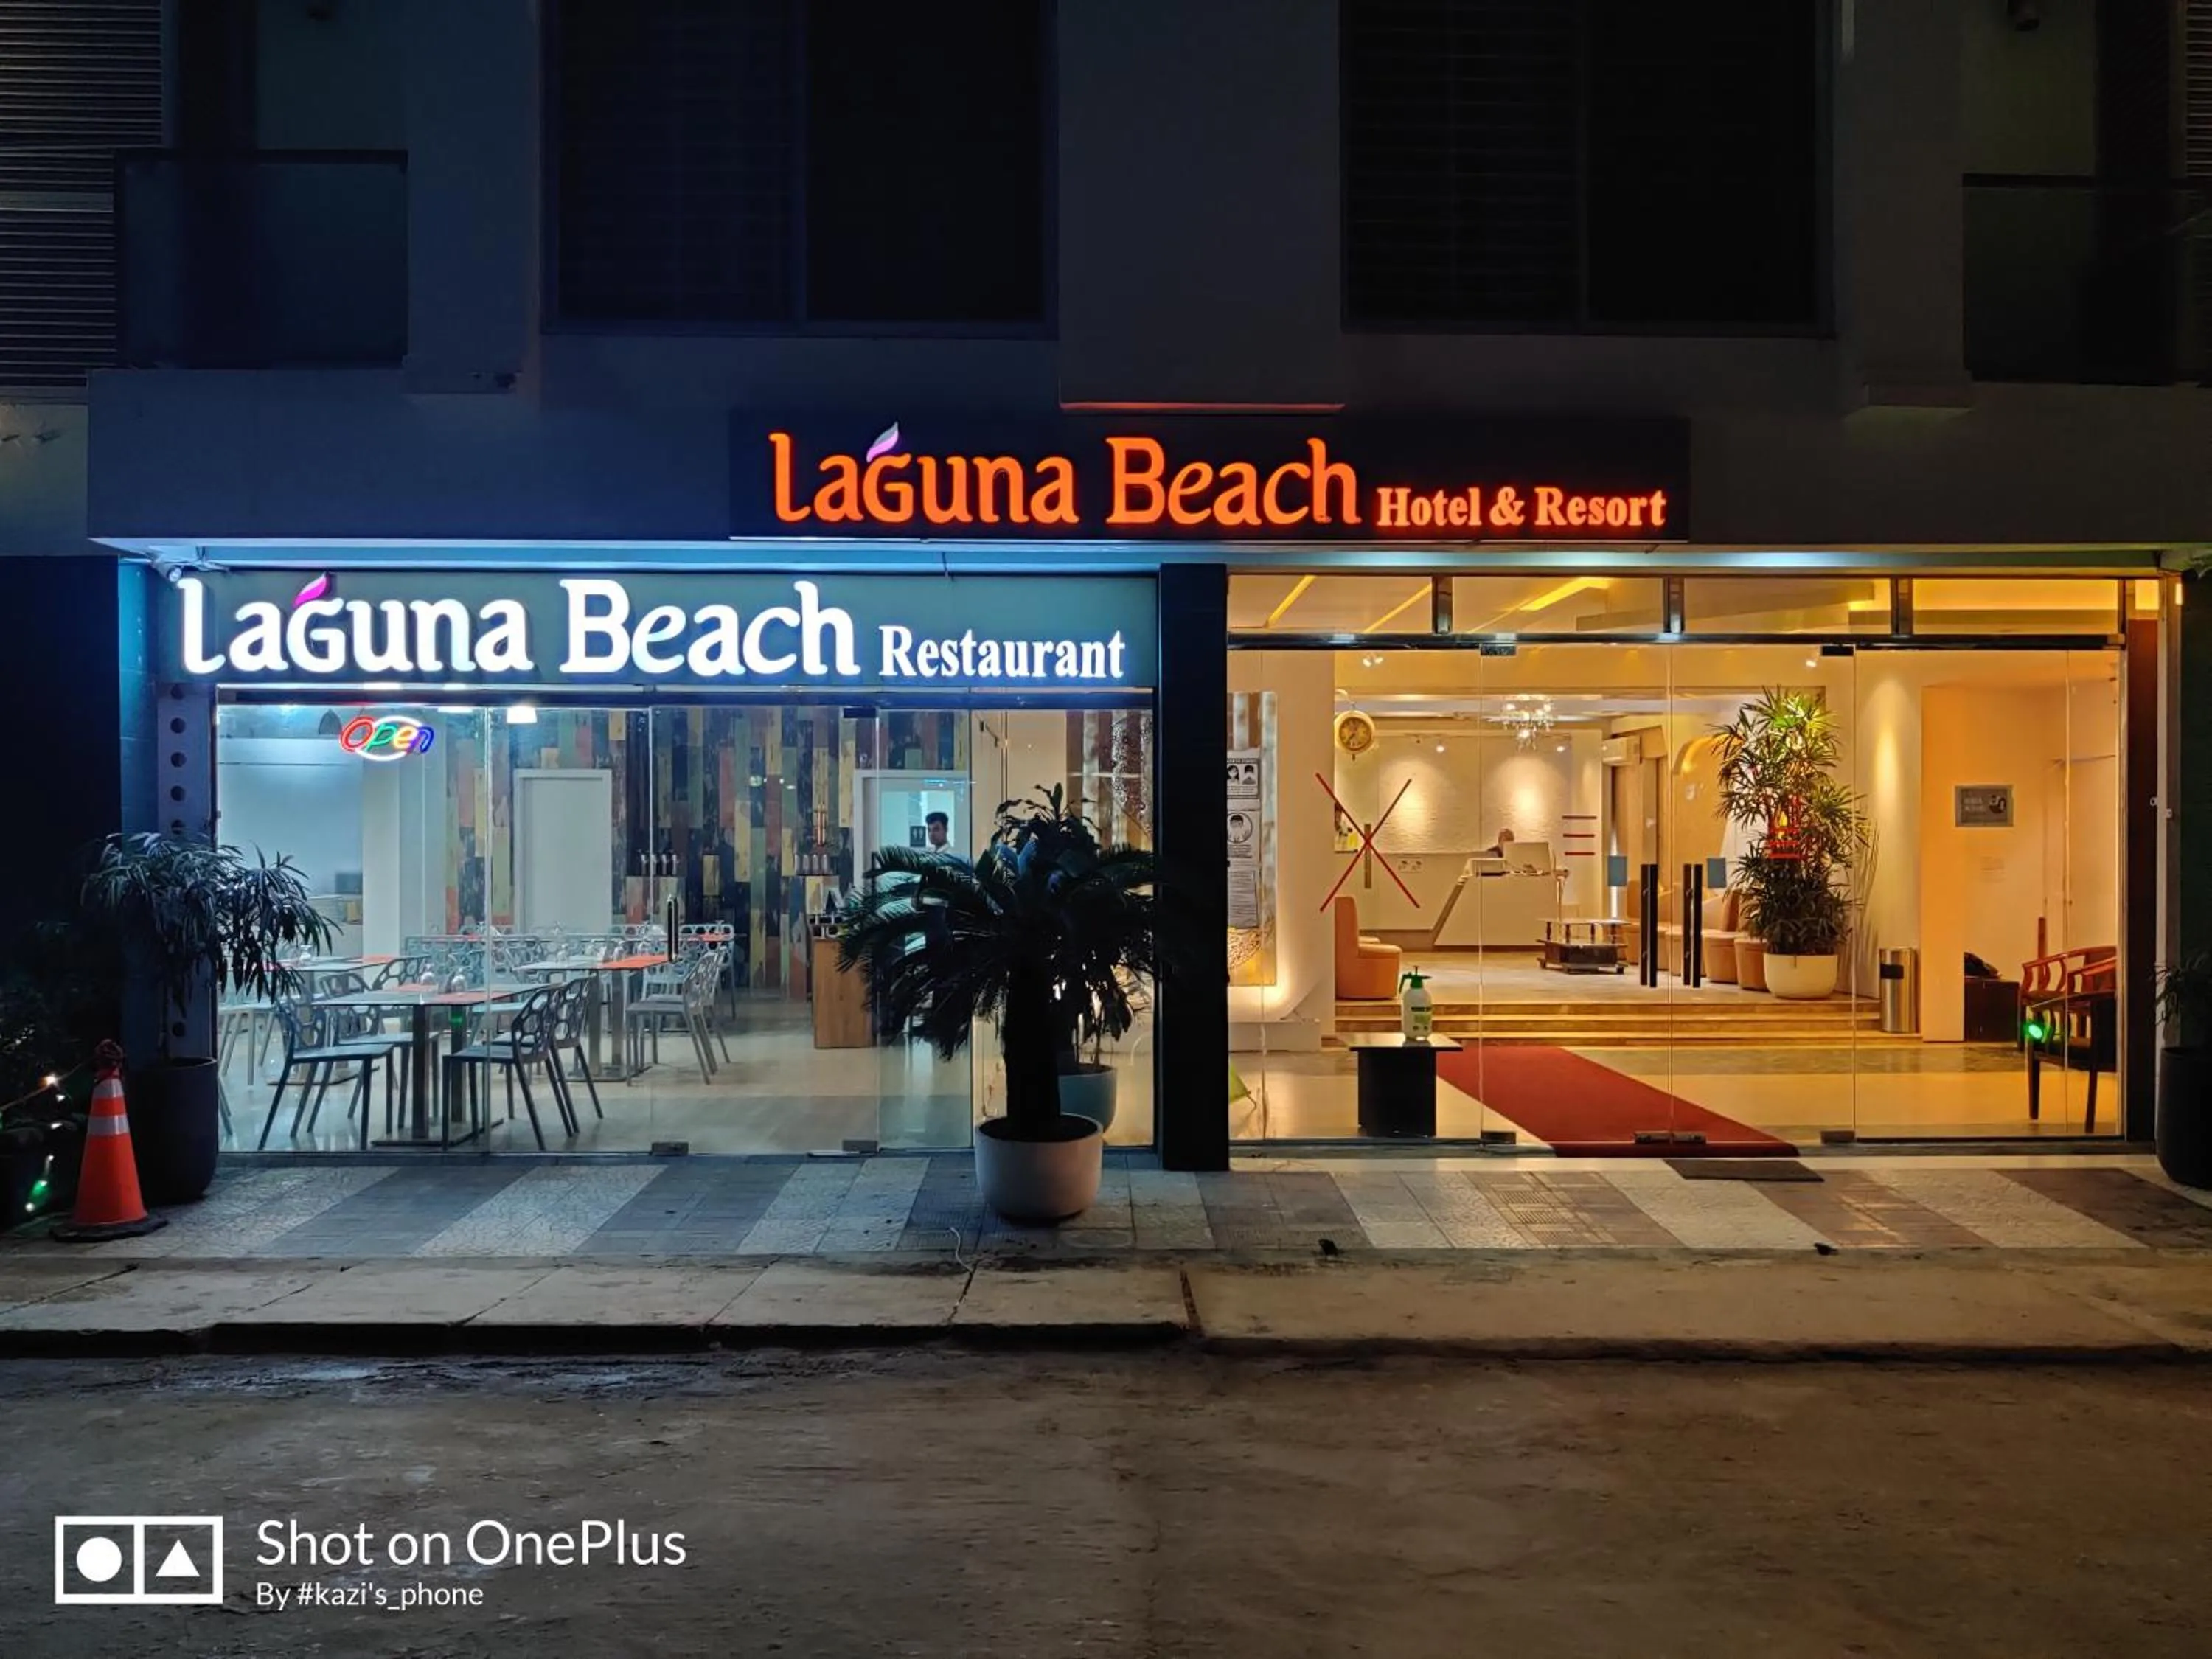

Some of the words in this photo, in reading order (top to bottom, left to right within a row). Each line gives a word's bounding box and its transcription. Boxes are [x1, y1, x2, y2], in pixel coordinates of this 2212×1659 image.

[1106, 437, 1362, 526] Beach
[1376, 486, 1482, 528] Hotel
[1489, 486, 1526, 527] &
[1534, 486, 1667, 528] Resort
[559, 579, 860, 677] Beach
[880, 625, 1125, 679] Restaurant
[341, 716, 434, 754] Open
